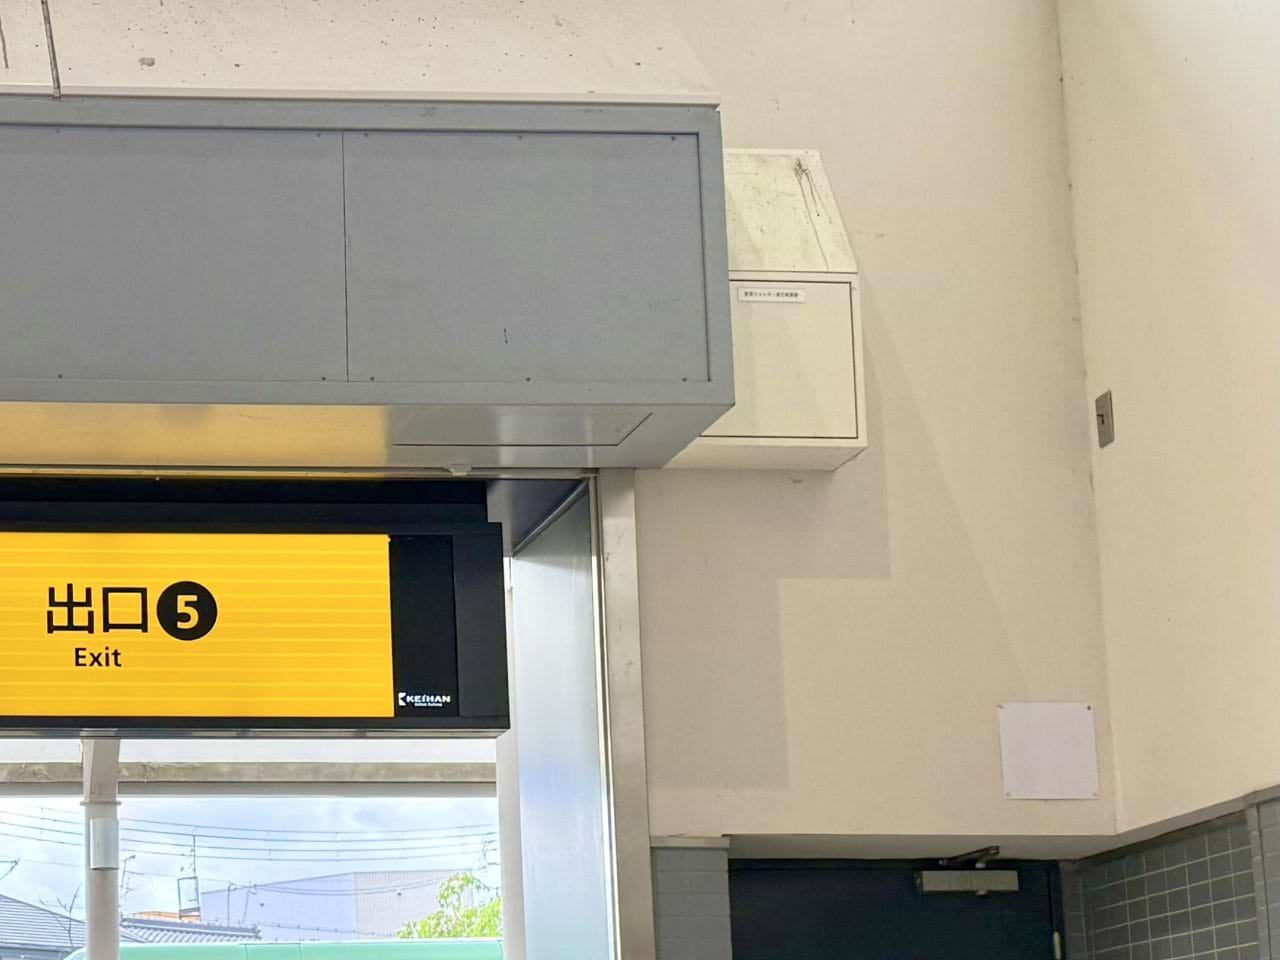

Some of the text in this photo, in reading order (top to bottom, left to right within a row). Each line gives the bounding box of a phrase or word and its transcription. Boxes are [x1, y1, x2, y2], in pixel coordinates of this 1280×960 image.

[47, 584, 149, 634] 出口
[74, 648, 122, 667] Exit
[406, 695, 451, 703] KEIHAN
